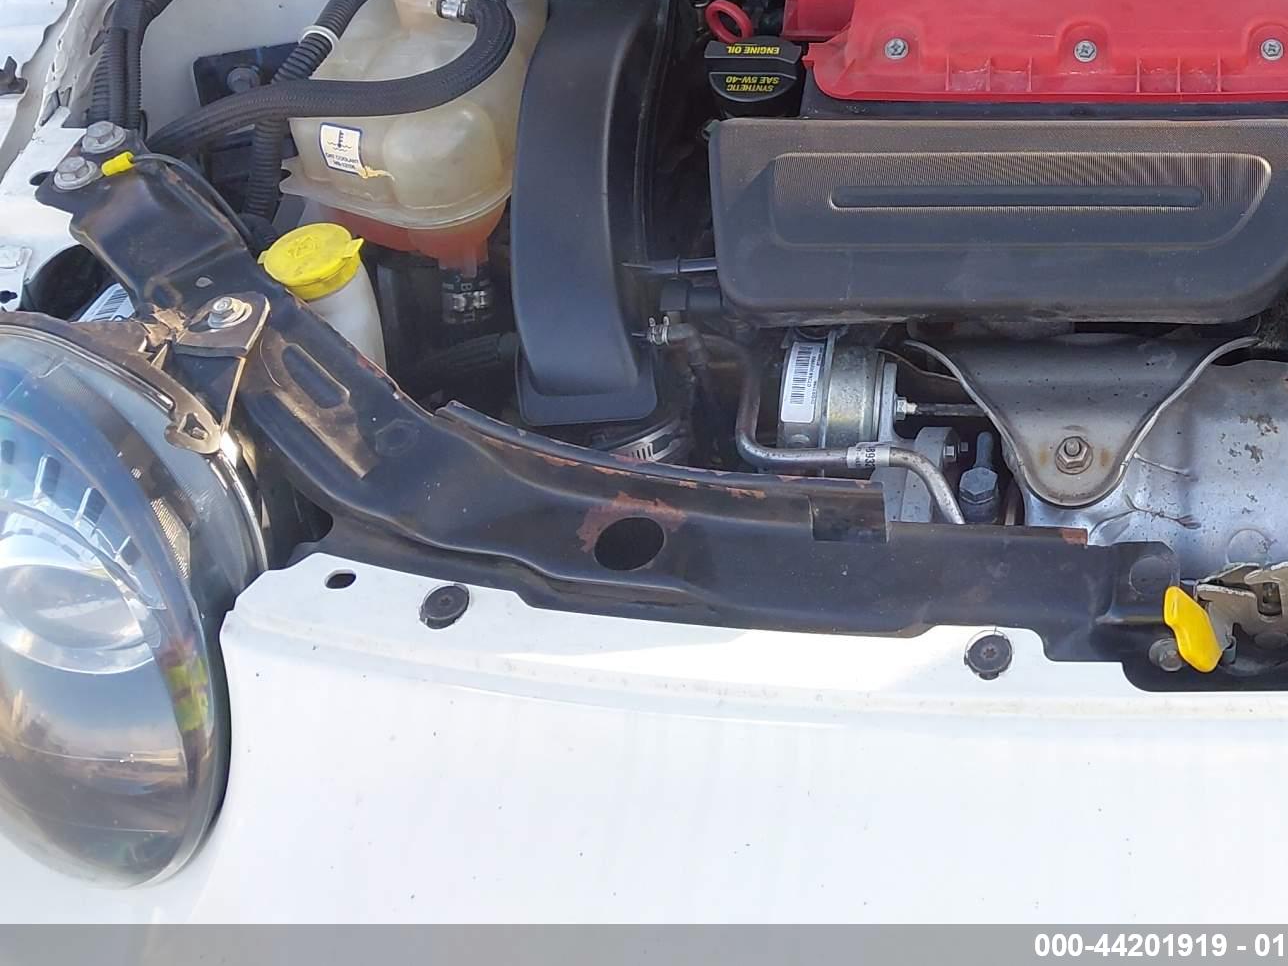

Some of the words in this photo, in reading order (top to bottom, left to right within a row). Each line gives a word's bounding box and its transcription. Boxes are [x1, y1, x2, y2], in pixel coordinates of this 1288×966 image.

[726, 46, 742, 54] OIL
[744, 46, 780, 54] ENGINE
[726, 76, 758, 84] 5W-40
[759, 76, 780, 84] SAE
[726, 84, 775, 92] SYNTHETIC
